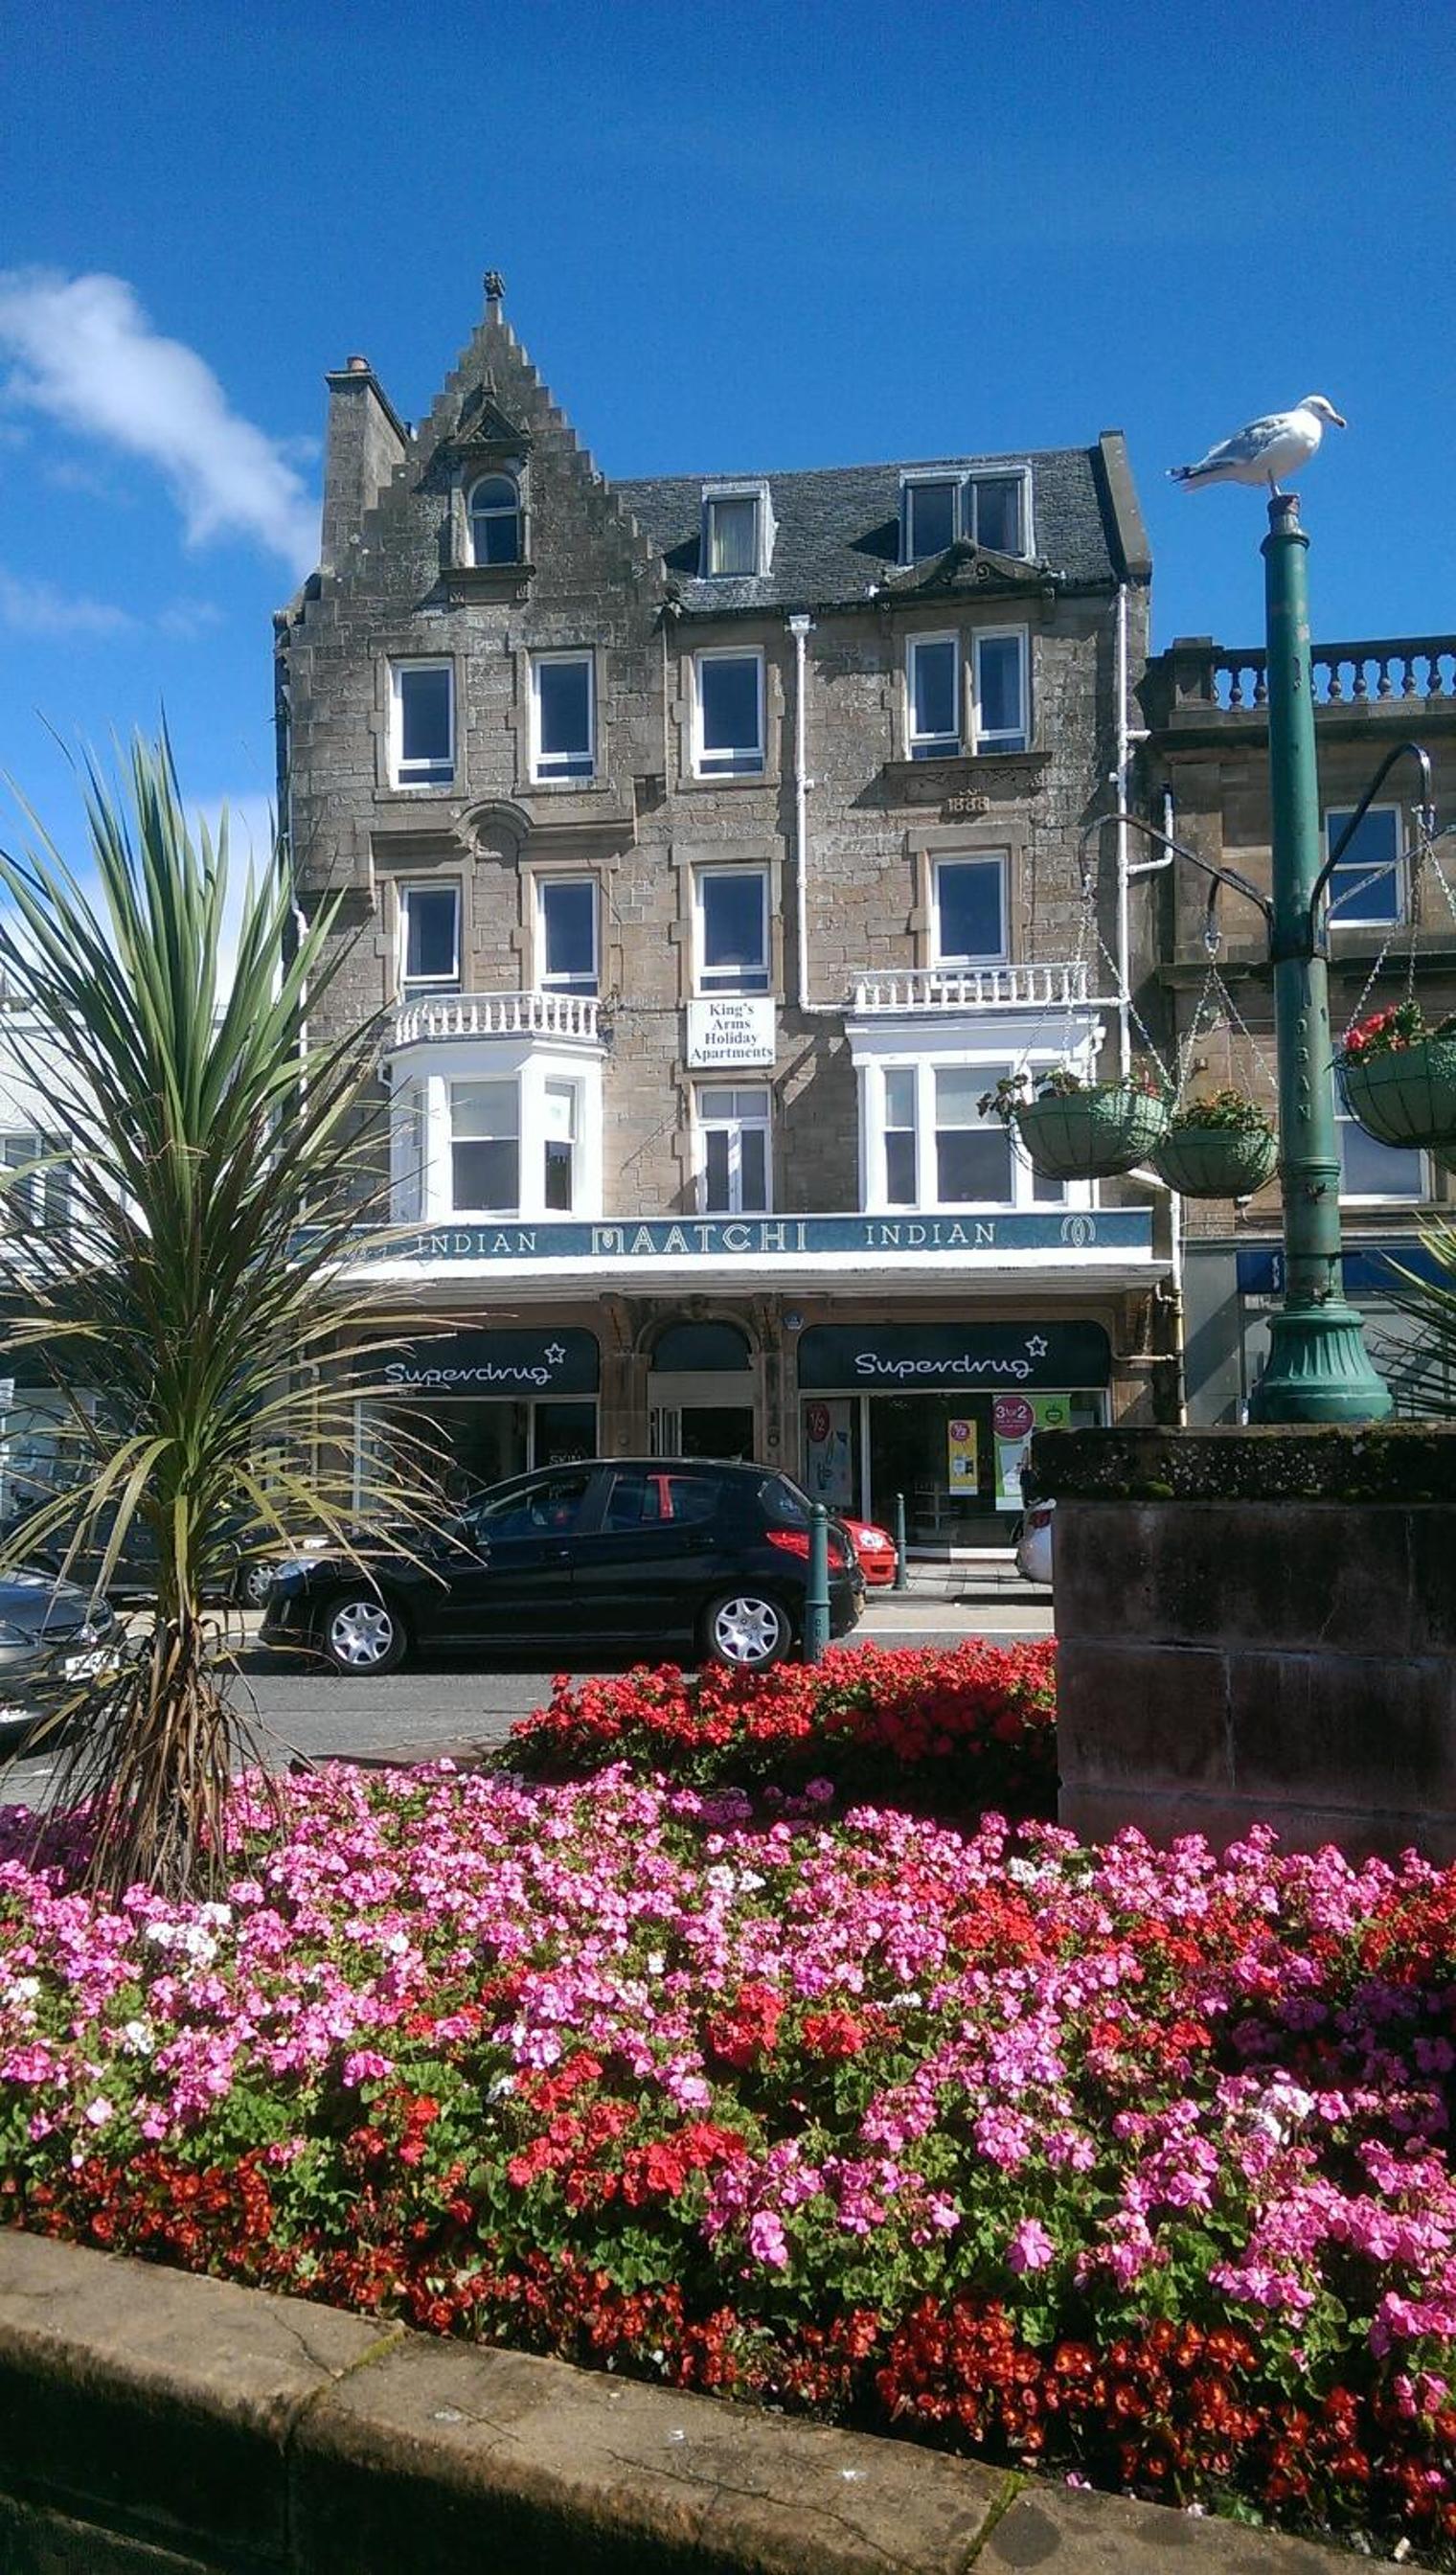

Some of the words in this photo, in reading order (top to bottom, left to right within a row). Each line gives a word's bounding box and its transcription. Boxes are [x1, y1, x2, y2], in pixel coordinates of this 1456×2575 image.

[710, 1002, 754, 1017] King's
[711, 1019, 751, 1031] Arms
[704, 1032, 757, 1047] Holiday
[690, 1047, 774, 1063] Apartments
[417, 1232, 537, 1254] INDIAN
[591, 1222, 807, 1254] MAATCHI
[865, 1222, 996, 1245] INDIAN
[384, 1362, 553, 1386] Superdrug
[854, 1353, 1034, 1379] Superdrug
